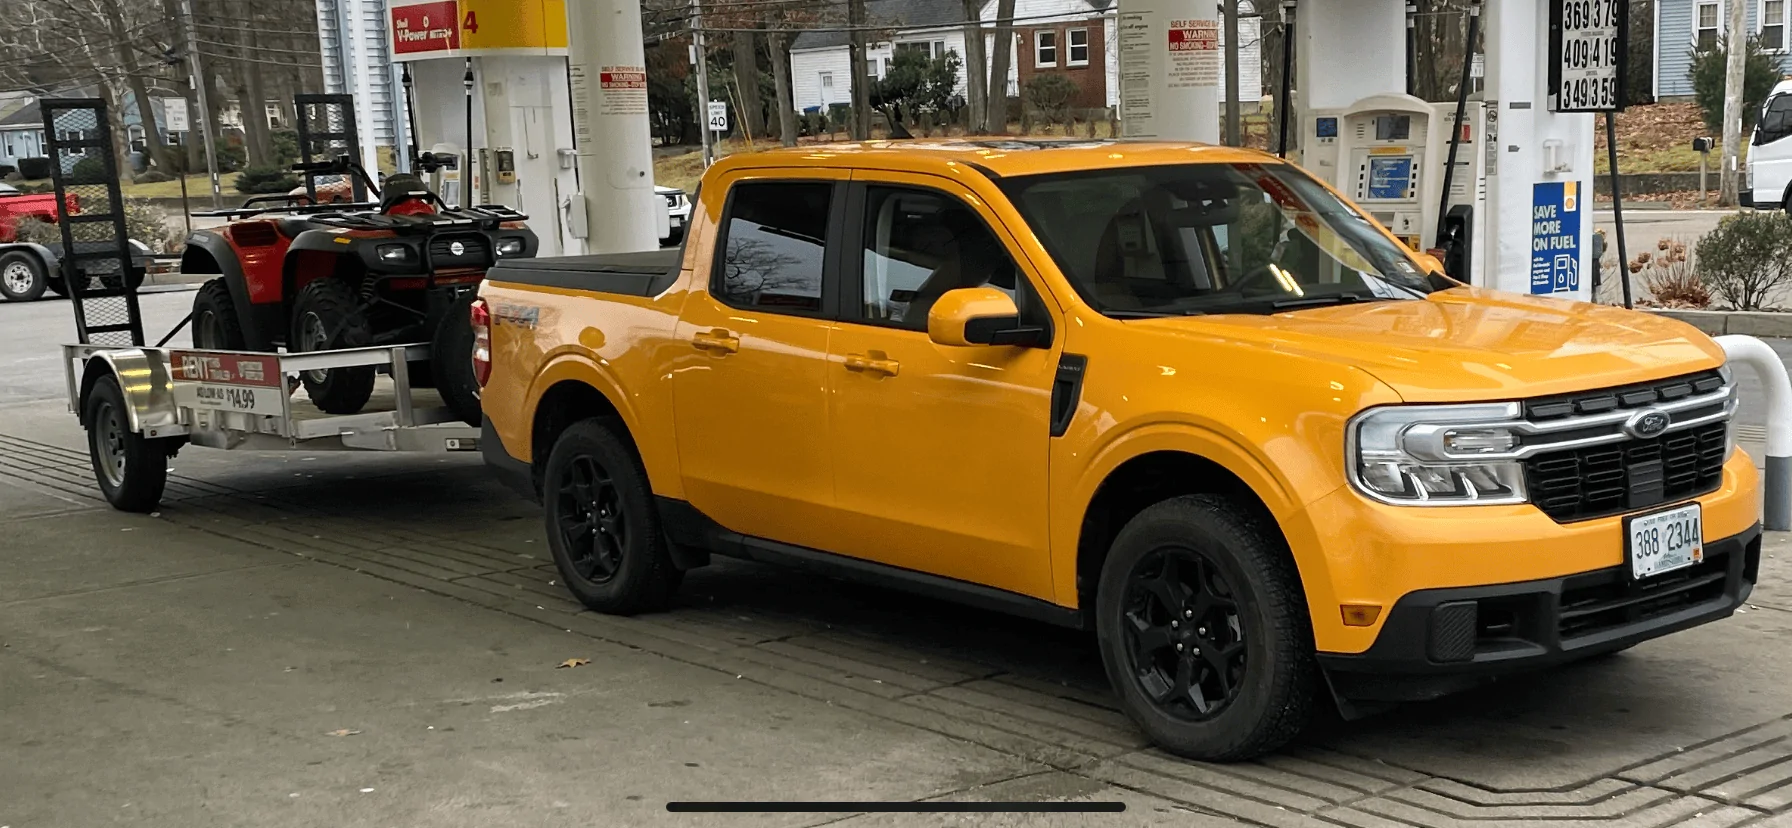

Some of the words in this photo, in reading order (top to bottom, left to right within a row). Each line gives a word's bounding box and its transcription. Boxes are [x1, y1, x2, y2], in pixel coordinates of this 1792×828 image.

[463, 10, 479, 34] 4
[1564, 1, 1590, 30] 369
[1593, 0, 1618, 28] 379
[1170, 20, 1187, 28] SELF
[1188, 20, 1210, 28] SERVICE
[397, 29, 428, 42] V-Power
[1169, 42, 1179, 51] NO
[1564, 39, 1588, 68] 409
[1592, 38, 1617, 67] 419
[610, 73, 642, 81] WARNING
[1563, 78, 1588, 108] 349
[1591, 77, 1616, 106] 359
[710, 116, 726, 127] 40
[1533, 205, 1557, 219] SAVE
[1533, 220, 1561, 235] MORE
[1533, 238, 1548, 251] ON
[1550, 235, 1577, 249] FUEL
[181, 355, 210, 379] RENT
[226, 388, 255, 409] $14.99
[1642, 416, 1664, 432] Ford
[1635, 527, 1660, 559] 388
[1666, 517, 1699, 551] 2344
